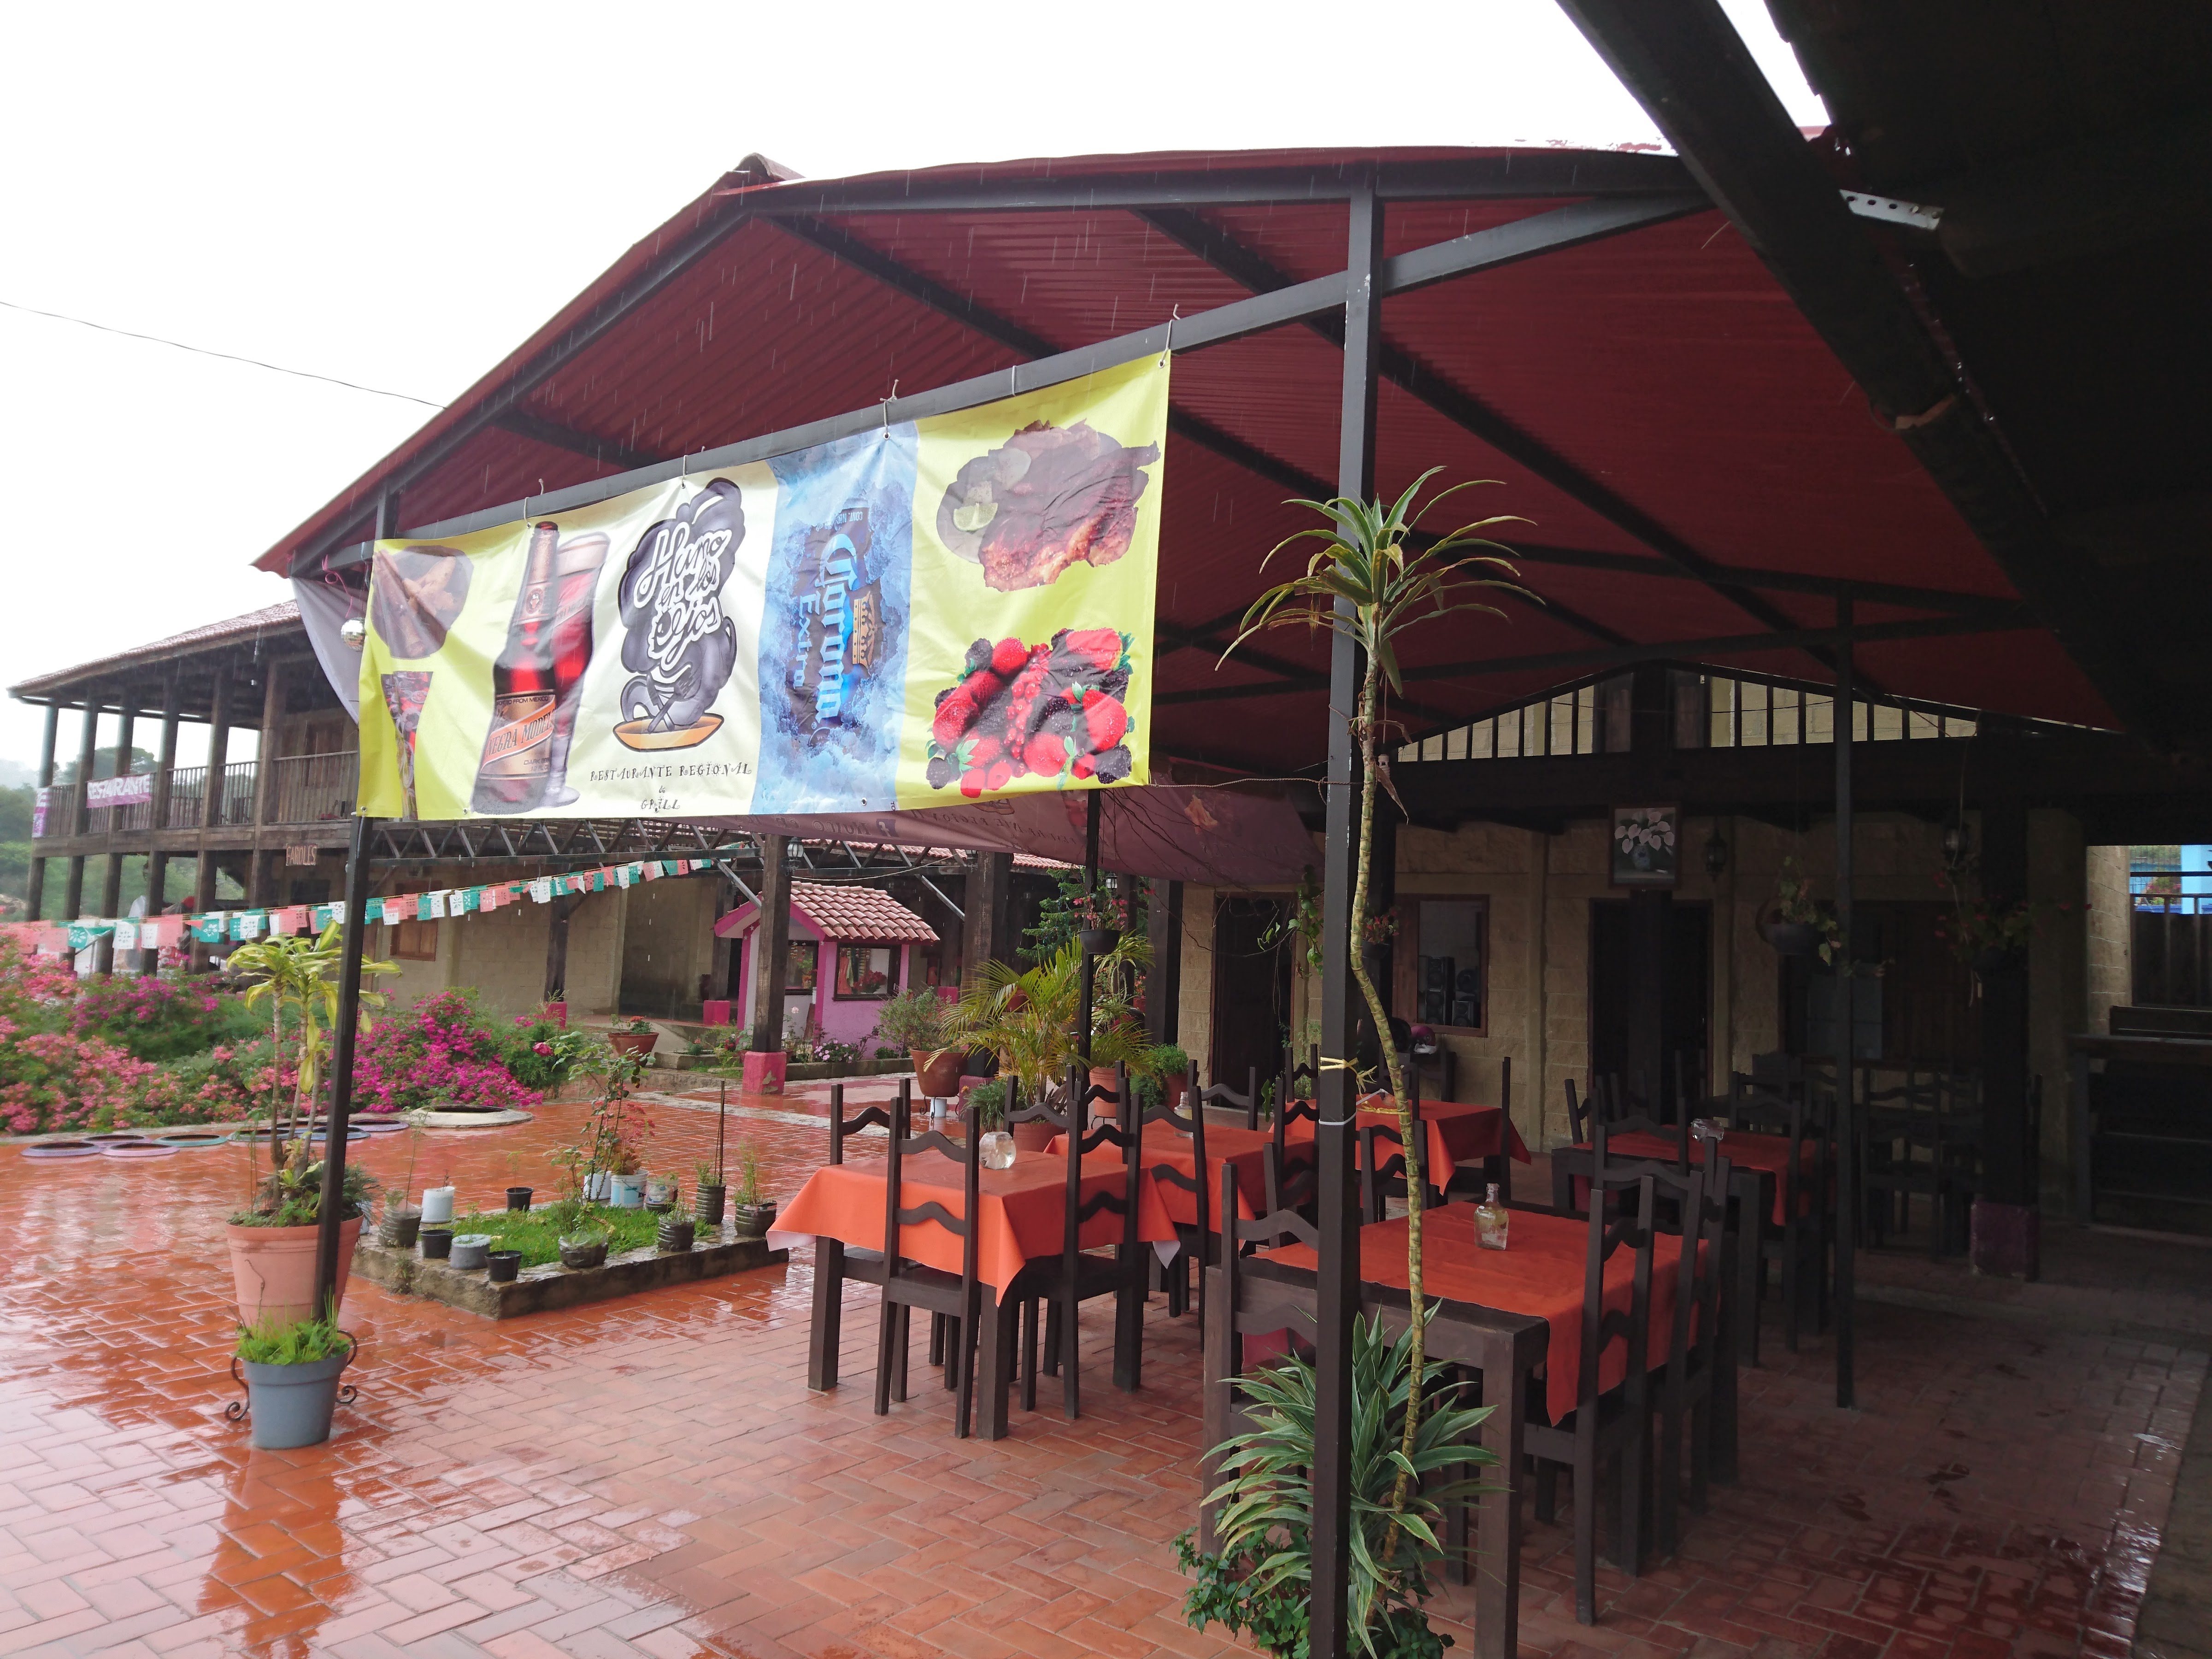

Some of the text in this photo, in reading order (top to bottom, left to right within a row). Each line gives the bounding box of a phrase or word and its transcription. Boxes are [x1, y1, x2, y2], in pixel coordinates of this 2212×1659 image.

[794, 590, 821, 689] Extra
[815, 533, 858, 724] Corona
[486, 729, 518, 757] NEGRA
[590, 761, 752, 782] RESTAURANTE REGIONAL
[659, 785, 666, 794] &
